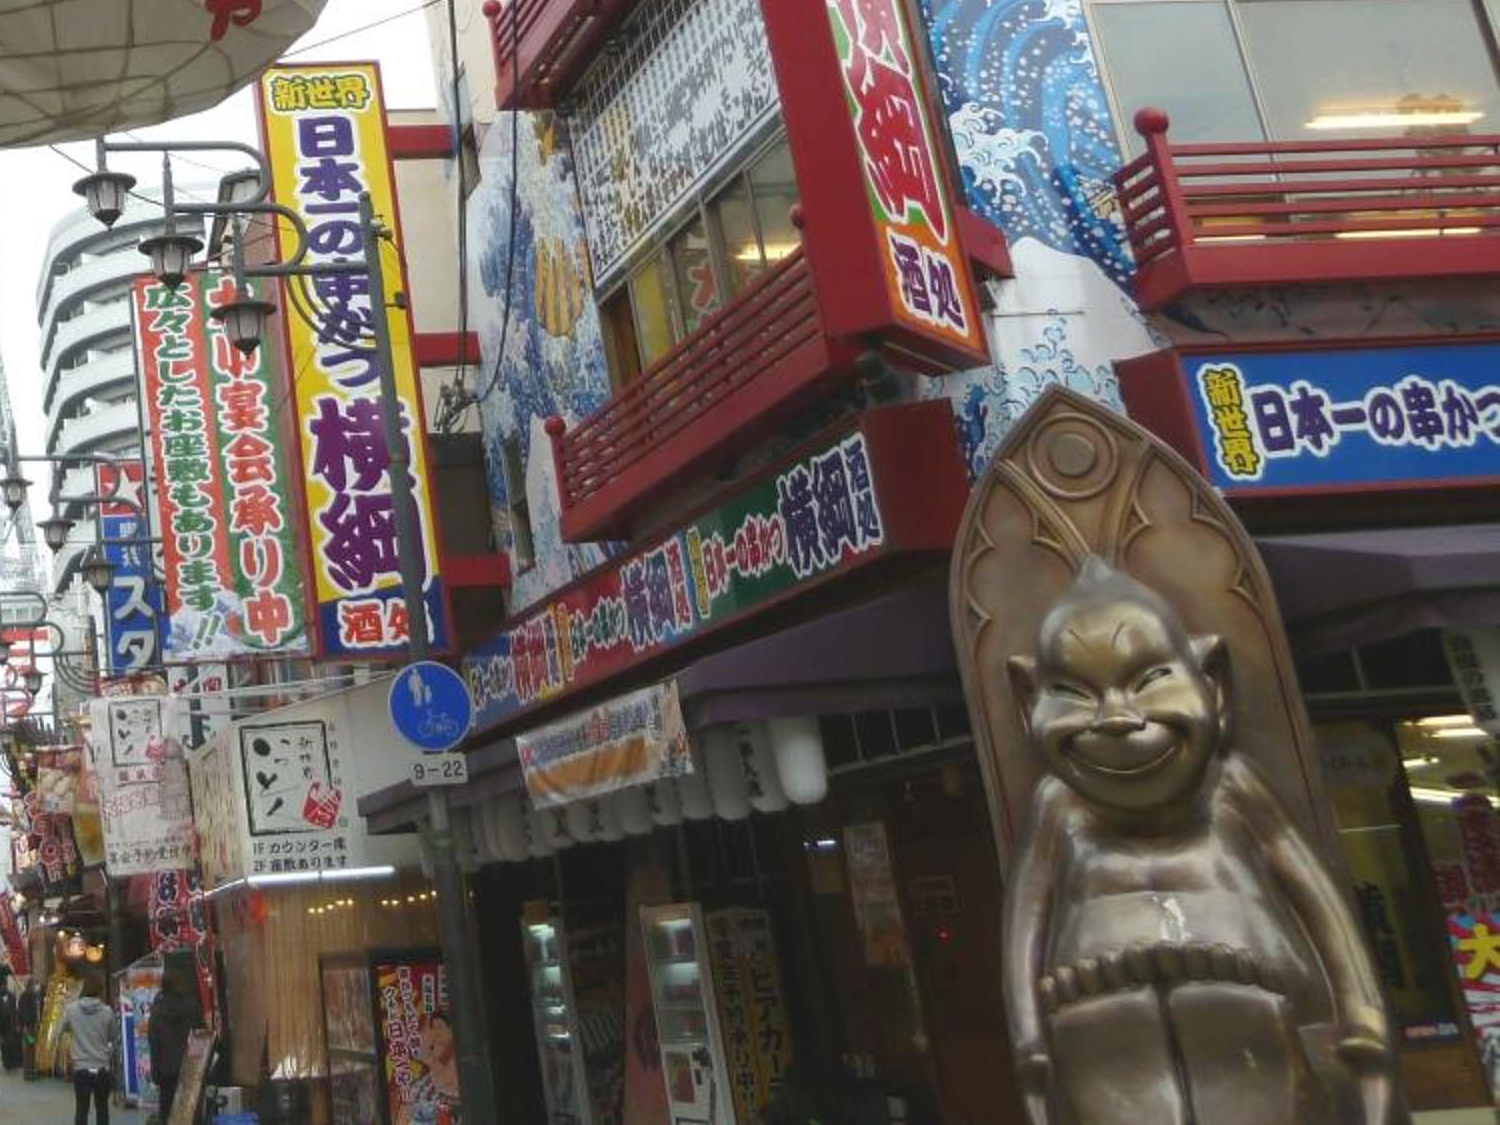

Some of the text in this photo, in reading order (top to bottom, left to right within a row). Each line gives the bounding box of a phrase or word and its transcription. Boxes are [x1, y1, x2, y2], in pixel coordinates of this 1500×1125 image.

[271, 75, 371, 111] 新世界
[893, 242, 966, 332] 酒処
[1204, 368, 1259, 474] 新世界
[413, 760, 464, 778] 9-22
